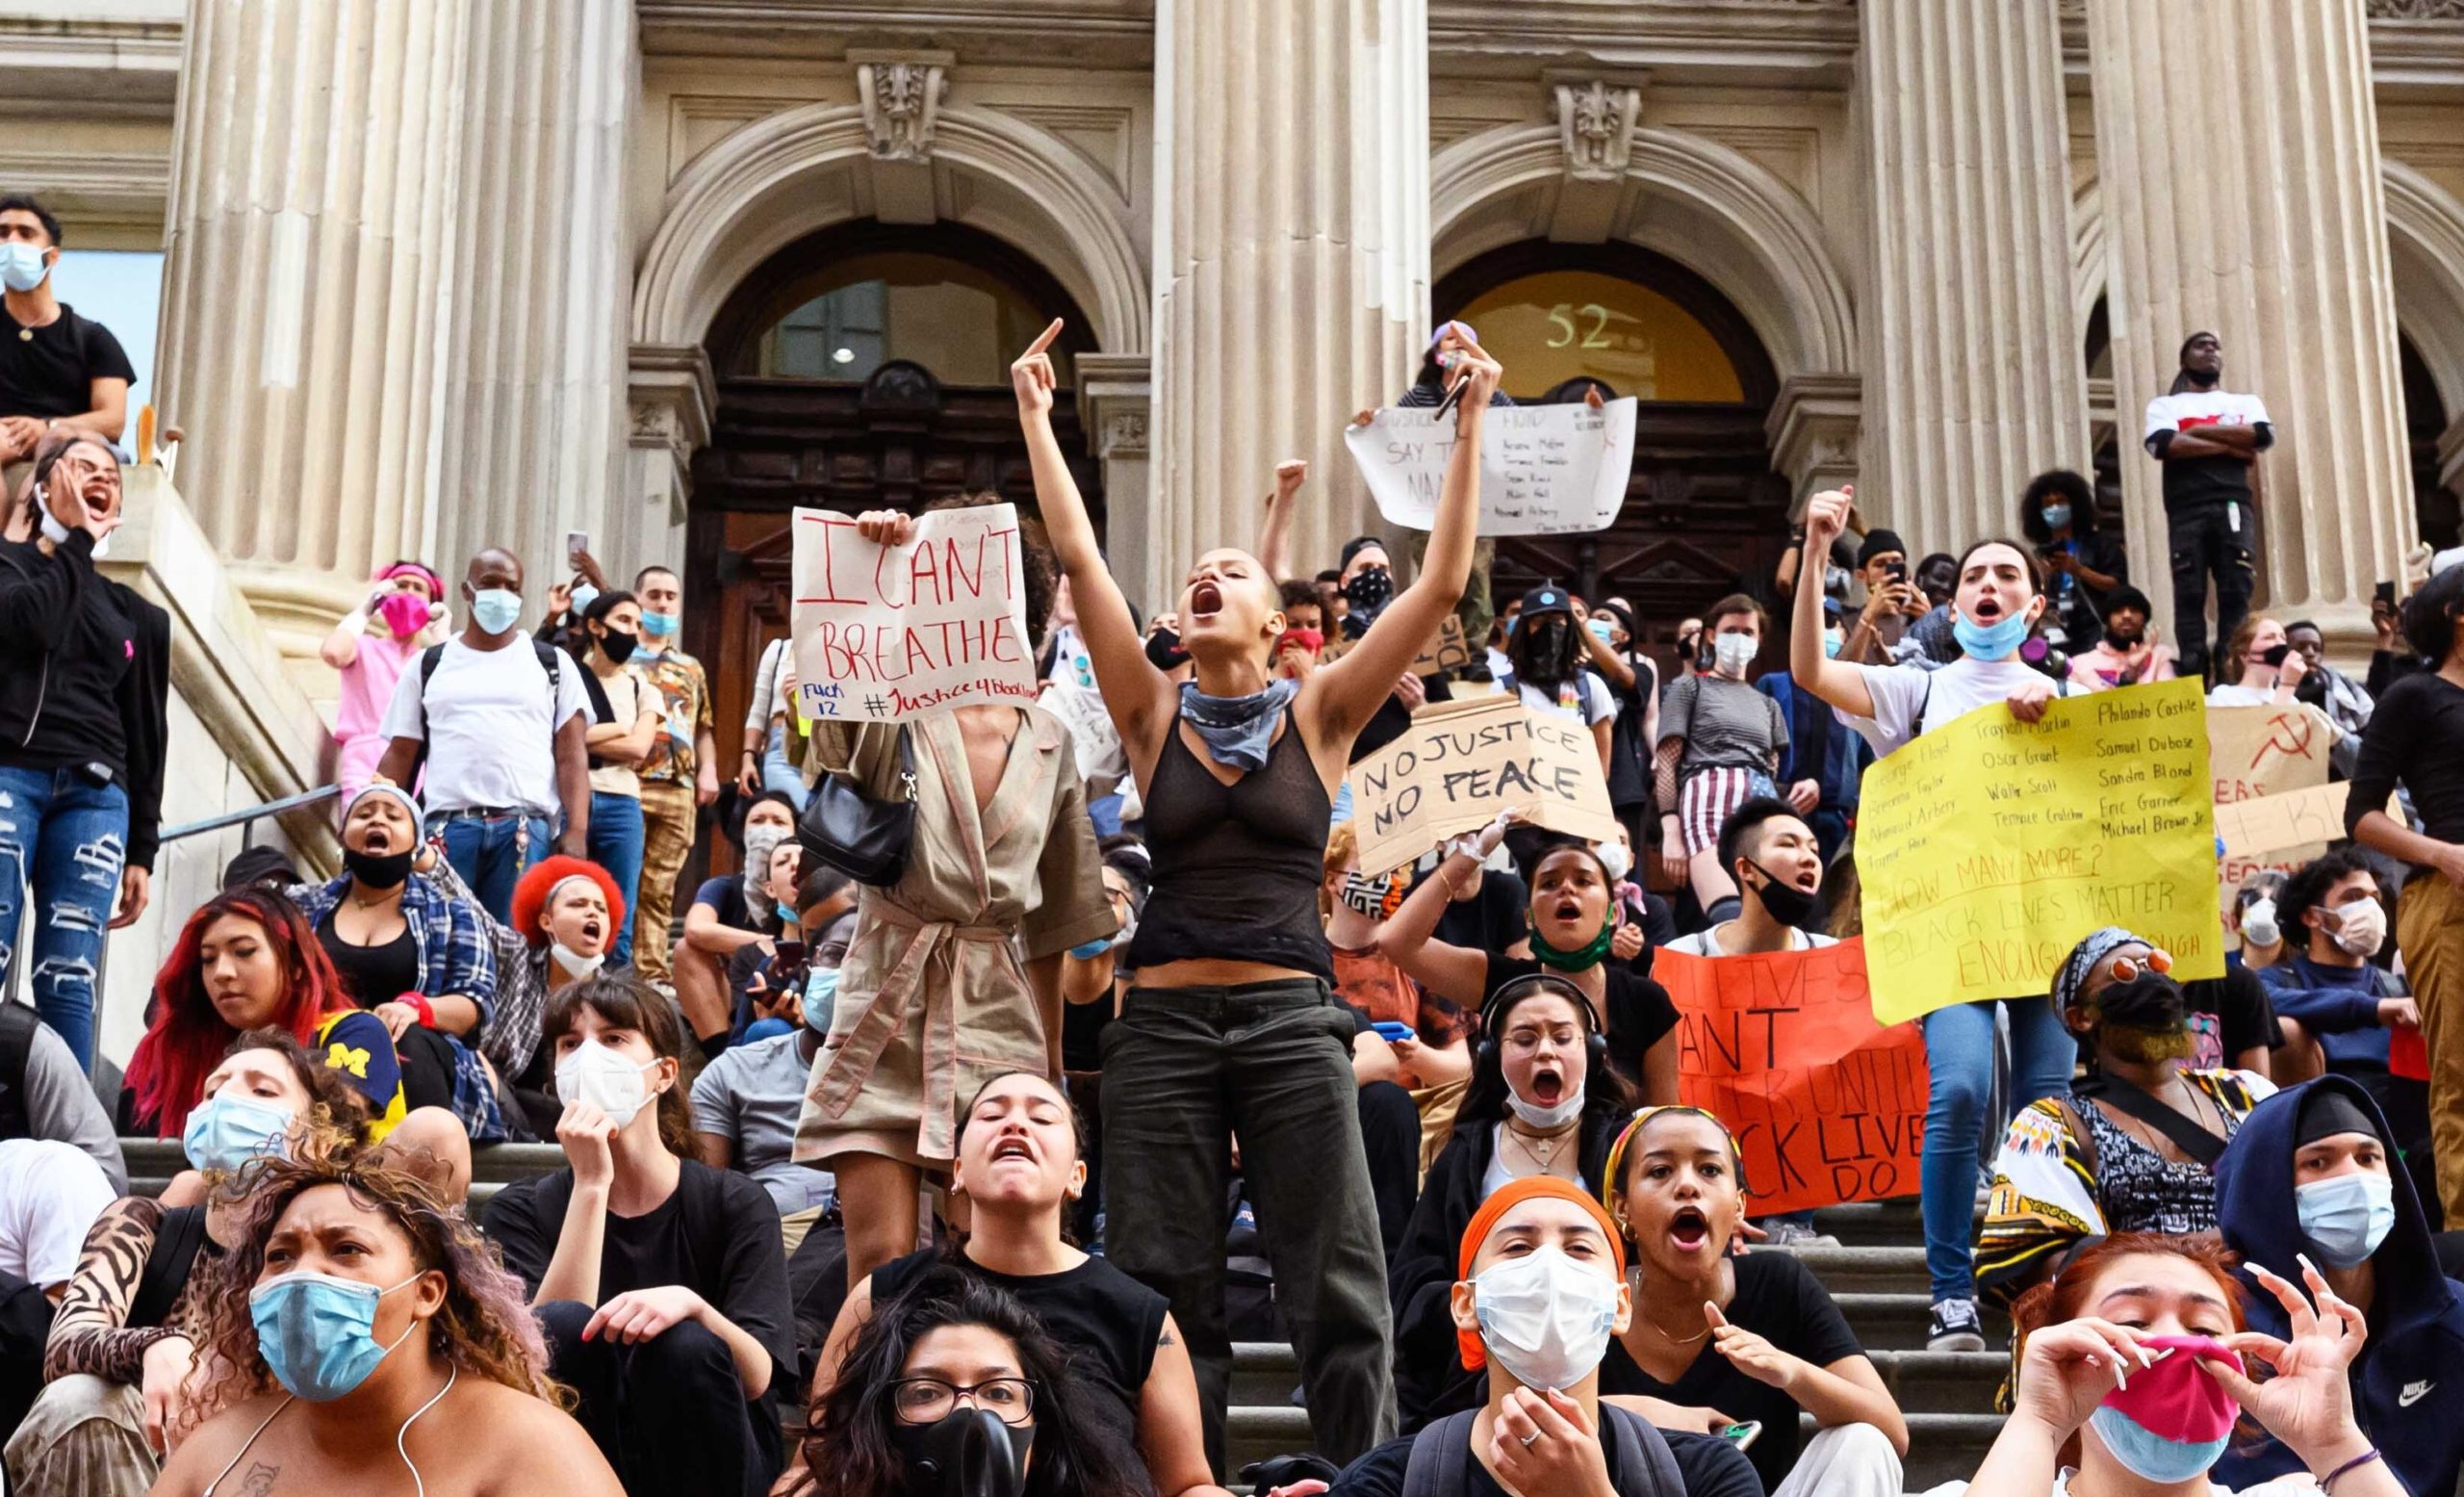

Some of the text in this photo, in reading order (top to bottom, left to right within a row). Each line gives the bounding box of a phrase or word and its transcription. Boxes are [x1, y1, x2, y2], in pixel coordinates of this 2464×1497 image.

[1547, 303, 1611, 348] 52
[1386, 441, 1424, 465] SAY
[795, 516, 1017, 608] I CAN'T
[820, 615, 1019, 682] BREATHE
[818, 701, 840, 715] 12
[2098, 697, 2196, 726] Philando Castile
[1365, 718, 1581, 797] NO JUSTICE
[2025, 745, 2059, 765] Grant
[2095, 737, 2141, 758] Samuel
[2098, 761, 2193, 787] Sandra Bland
[1374, 758, 1581, 835] NO PEACE
[2099, 796, 2126, 818] Eric
[2101, 816, 2147, 840] Michael
[2153, 815, 2189, 834] Brown
[1879, 868, 1941, 922] HOW
[1956, 851, 2016, 889] MANY
[1881, 905, 1983, 967] BLACK
[1998, 891, 2065, 932] LIVES
[2076, 881, 2176, 922] MATTER
[1710, 945, 1869, 1010] LIVES
[1833, 1161, 1897, 1201] DO
[2403, 1380, 2426, 1397] NIKE
